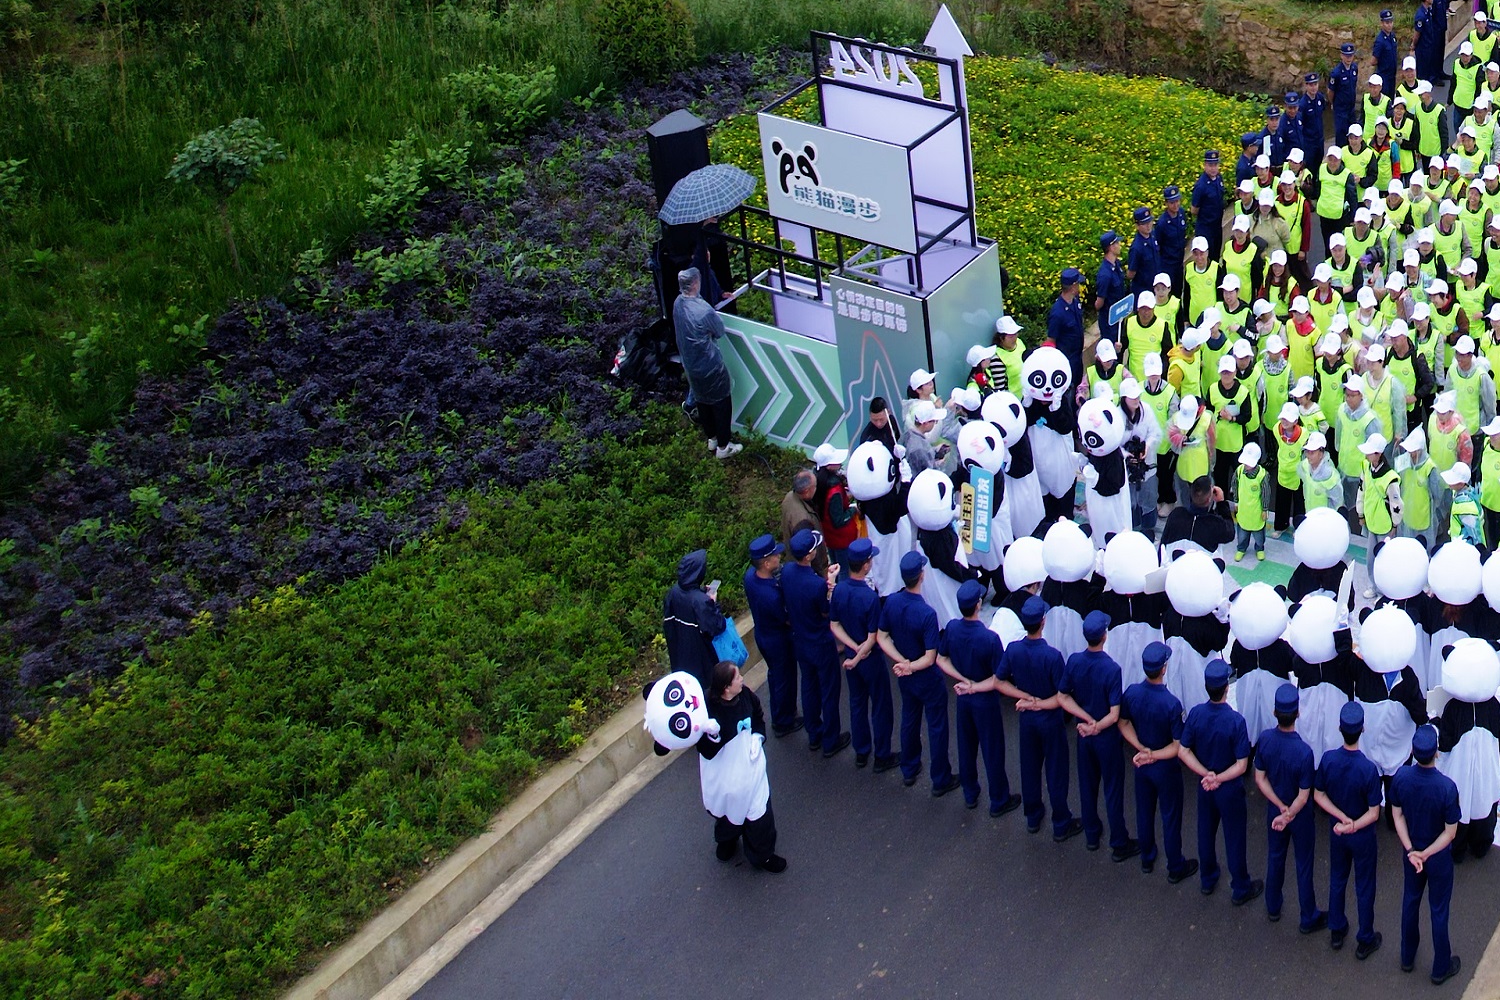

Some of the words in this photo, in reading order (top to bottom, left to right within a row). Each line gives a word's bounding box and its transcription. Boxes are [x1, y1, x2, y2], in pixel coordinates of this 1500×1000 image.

[794, 184, 878, 219] 熊猫漫步
[836, 288, 906, 317] 心情决定目的地
[974, 477, 990, 542] 即刻出发
